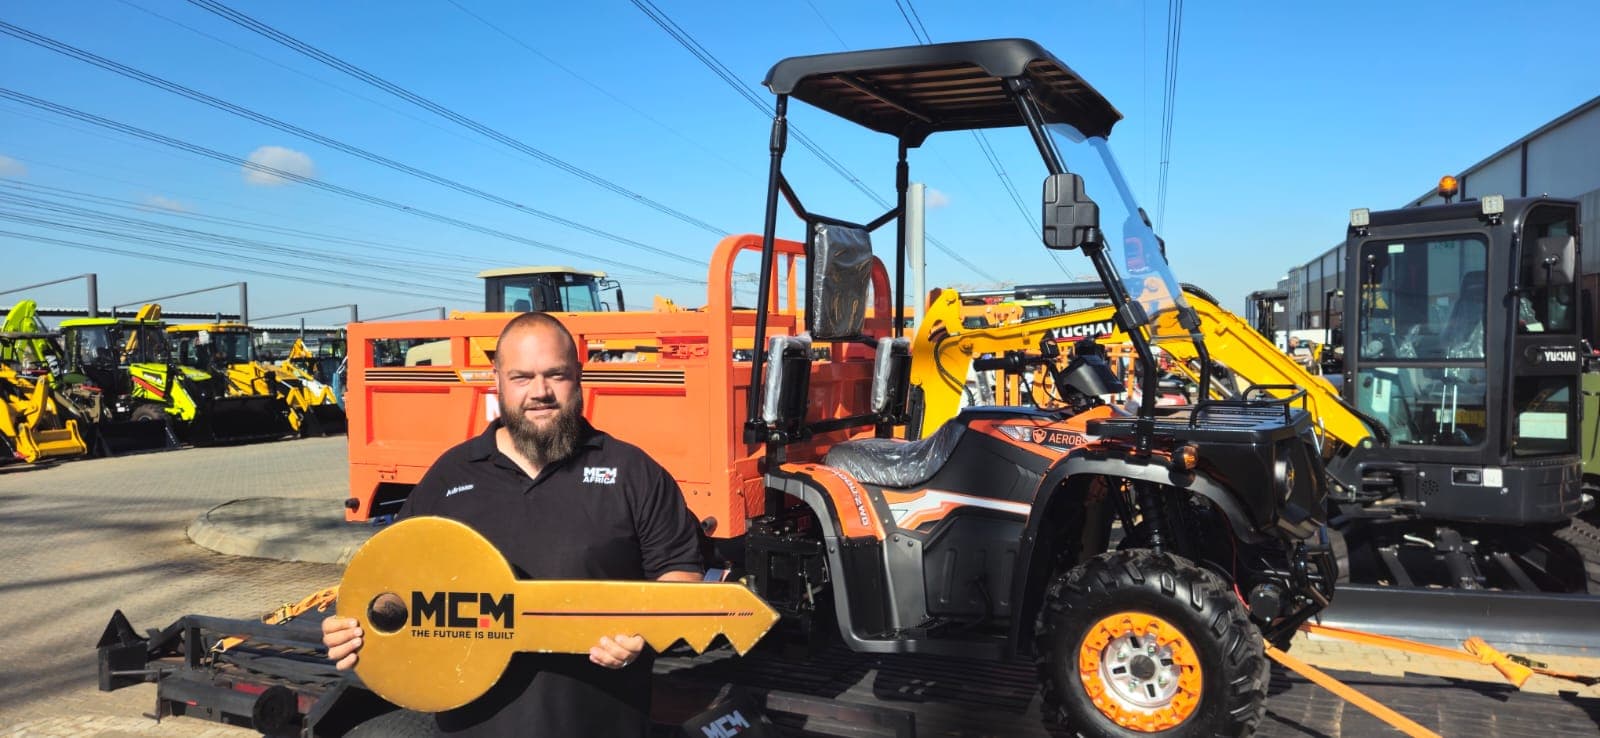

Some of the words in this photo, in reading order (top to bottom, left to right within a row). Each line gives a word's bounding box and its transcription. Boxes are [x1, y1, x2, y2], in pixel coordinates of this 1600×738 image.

[1052, 322, 1113, 339] YUCHAI
[1544, 351, 1576, 361] YUCHAI
[583, 467, 617, 478] MCM
[582, 476, 616, 484] AFRICA
[411, 591, 514, 629] MCM
[701, 709, 751, 738] MCM
